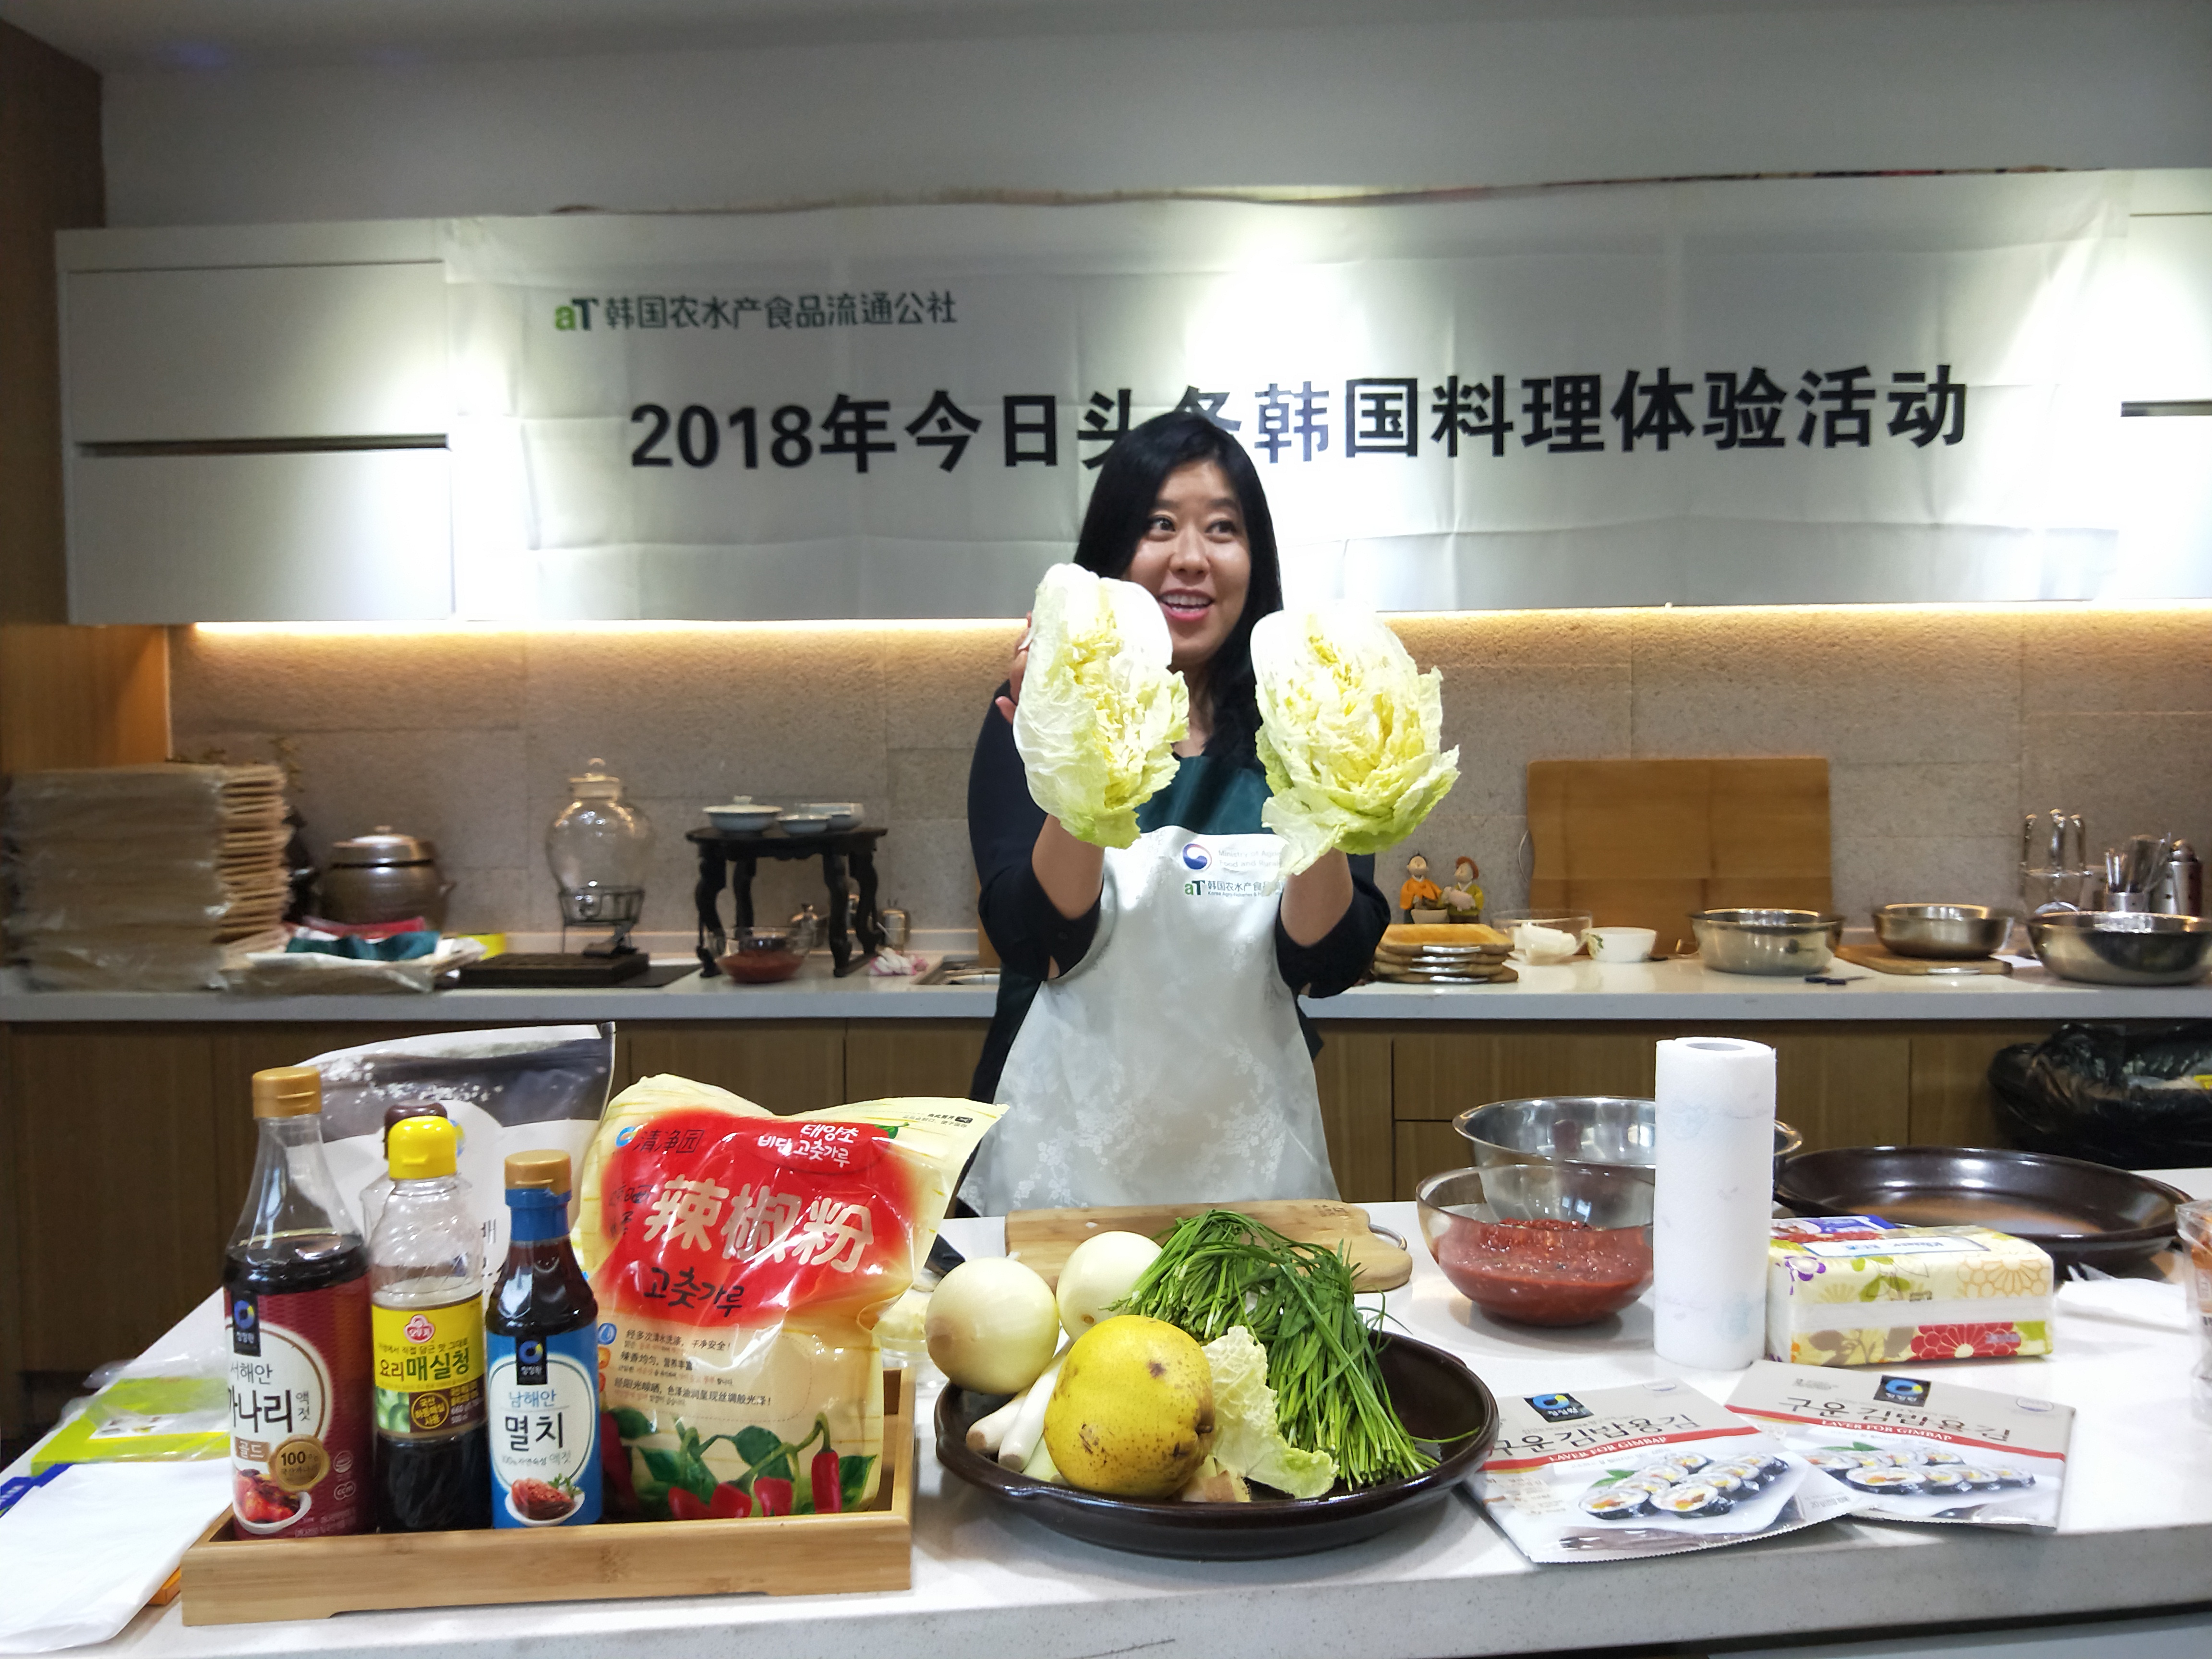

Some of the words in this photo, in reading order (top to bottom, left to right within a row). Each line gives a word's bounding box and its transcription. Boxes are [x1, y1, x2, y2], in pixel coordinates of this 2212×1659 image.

[555, 298, 599, 331] aT
[604, 291, 957, 330] 韩国农水产食品流通公社
[1184, 880, 1205, 896] aT
[633, 1129, 705, 1153] 清净园
[800, 1124, 859, 1143] 태양초
[793, 1138, 851, 1168] 고춧가루
[643, 1173, 875, 1274] 辣椒粉
[643, 1266, 745, 1318] 고춧가루
[230, 1360, 273, 1385] 서해안
[380, 1358, 404, 1382] 요리
[406, 1346, 469, 1381] 매실청
[509, 1388, 557, 1408] 남해안
[505, 1412, 564, 1452] 멸치
[1822, 1419, 1862, 1430] LAVER
[1866, 1424, 1893, 1432] FOR
[1897, 1427, 1952, 1441] GIMBAP
[238, 1441, 265, 1460] 골드
[1549, 1449, 1589, 1462] LAVER
[1590, 1444, 1616, 1455] FOR
[1616, 1436, 1667, 1449] GIMBAP
